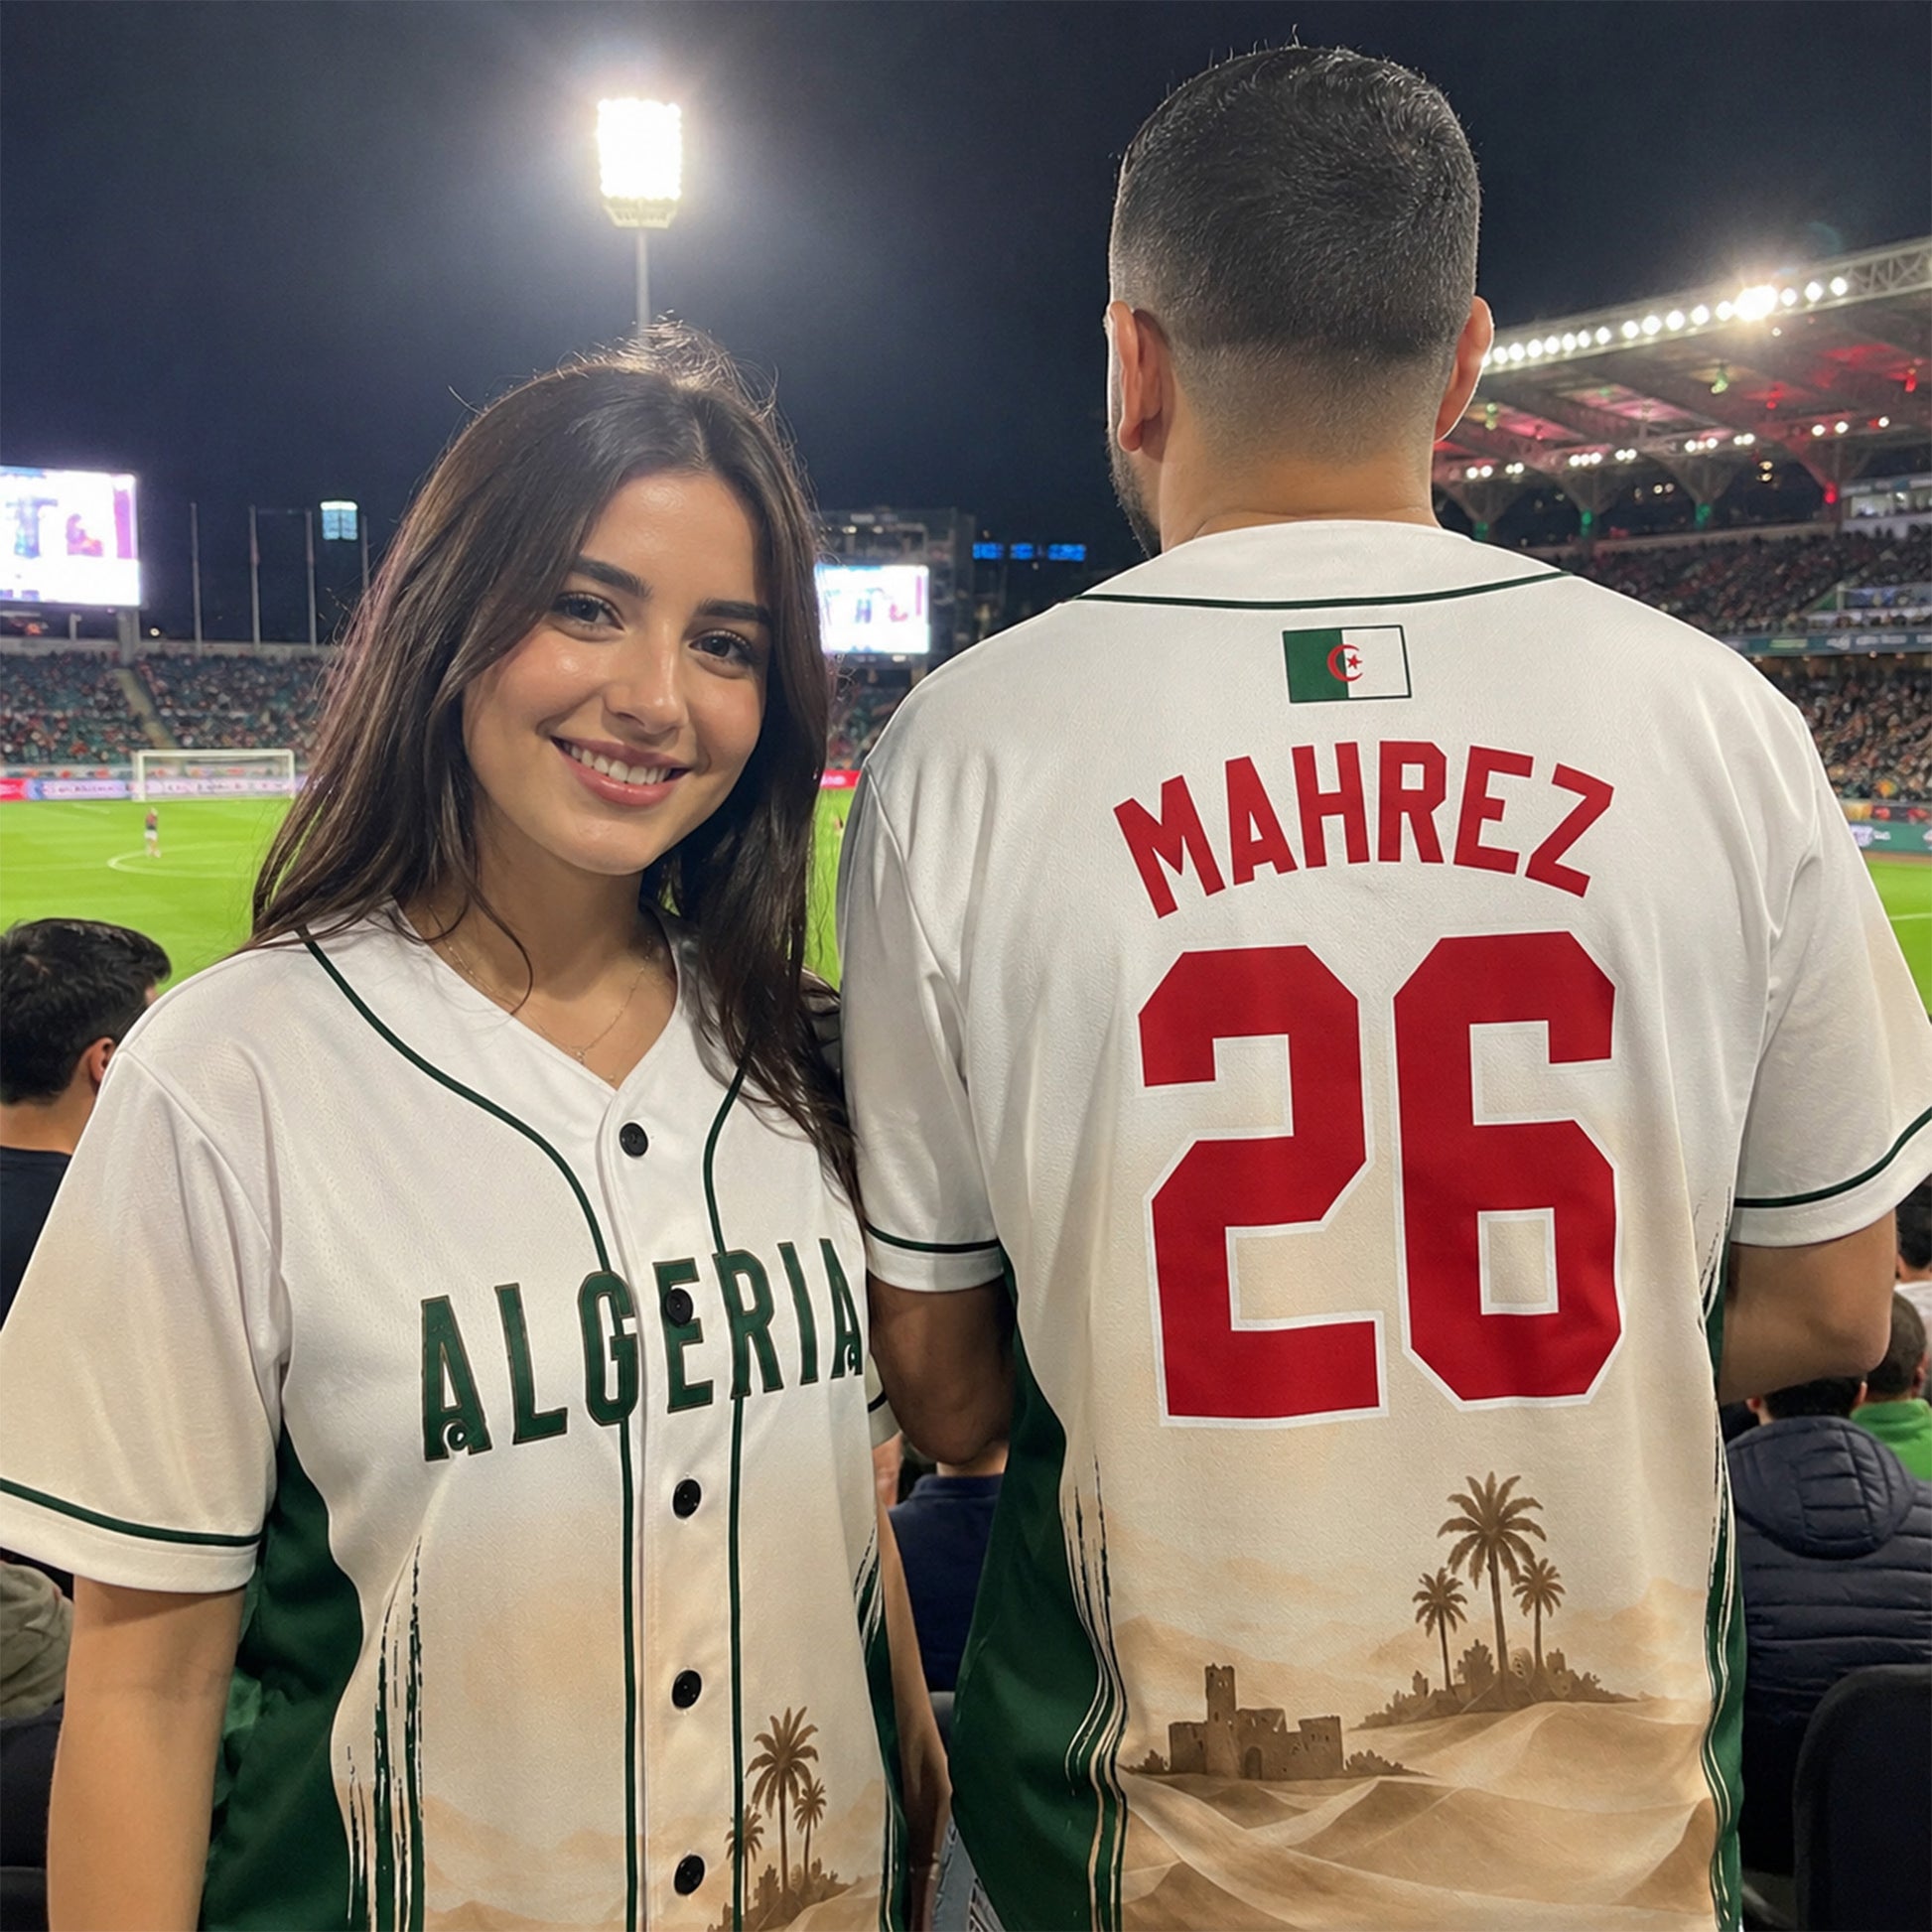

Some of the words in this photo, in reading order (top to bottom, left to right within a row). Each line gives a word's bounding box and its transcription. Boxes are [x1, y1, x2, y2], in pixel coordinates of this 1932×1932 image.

[1113, 740, 1615, 919] MAHREZ
[1137, 929, 1624, 1424] 26
[420, 1237, 864, 1462] ALGERIA
